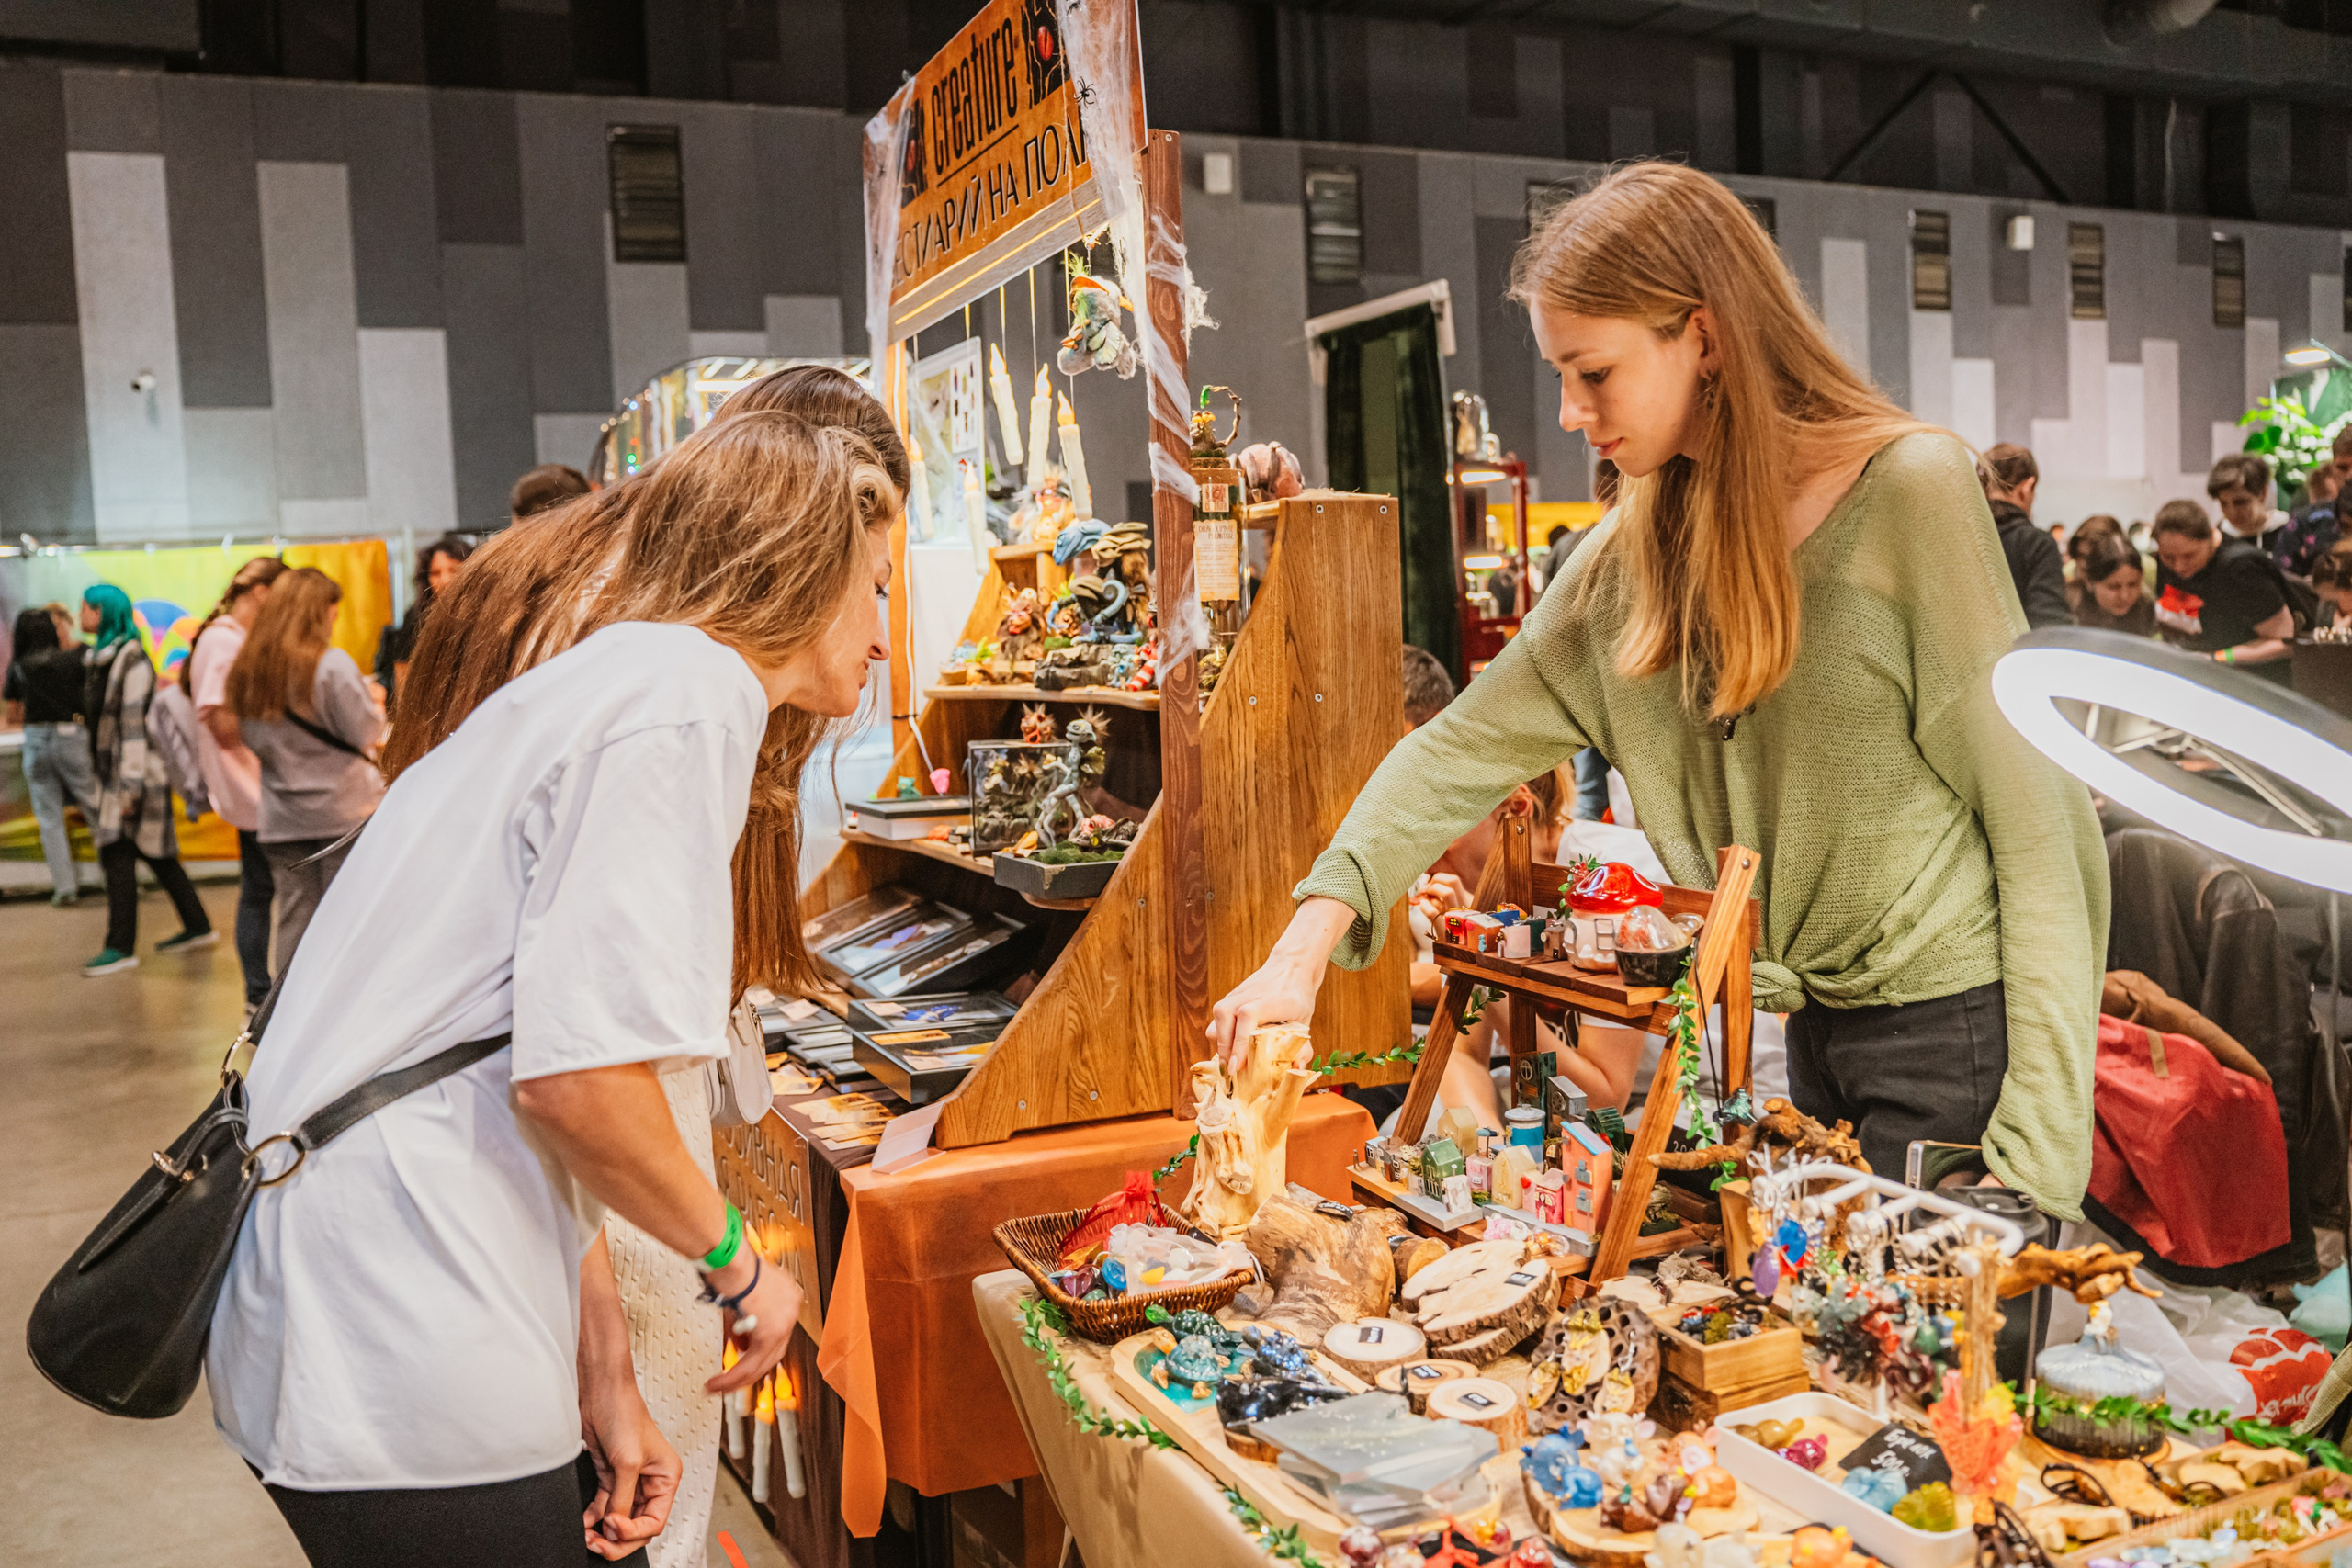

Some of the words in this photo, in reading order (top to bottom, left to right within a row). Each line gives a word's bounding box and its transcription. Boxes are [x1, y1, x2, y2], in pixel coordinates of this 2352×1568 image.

[931, 17, 1017, 175] creature
[892, 174, 988, 287] ЕСТИАРИЙ
[989, 158, 1021, 223] НА
